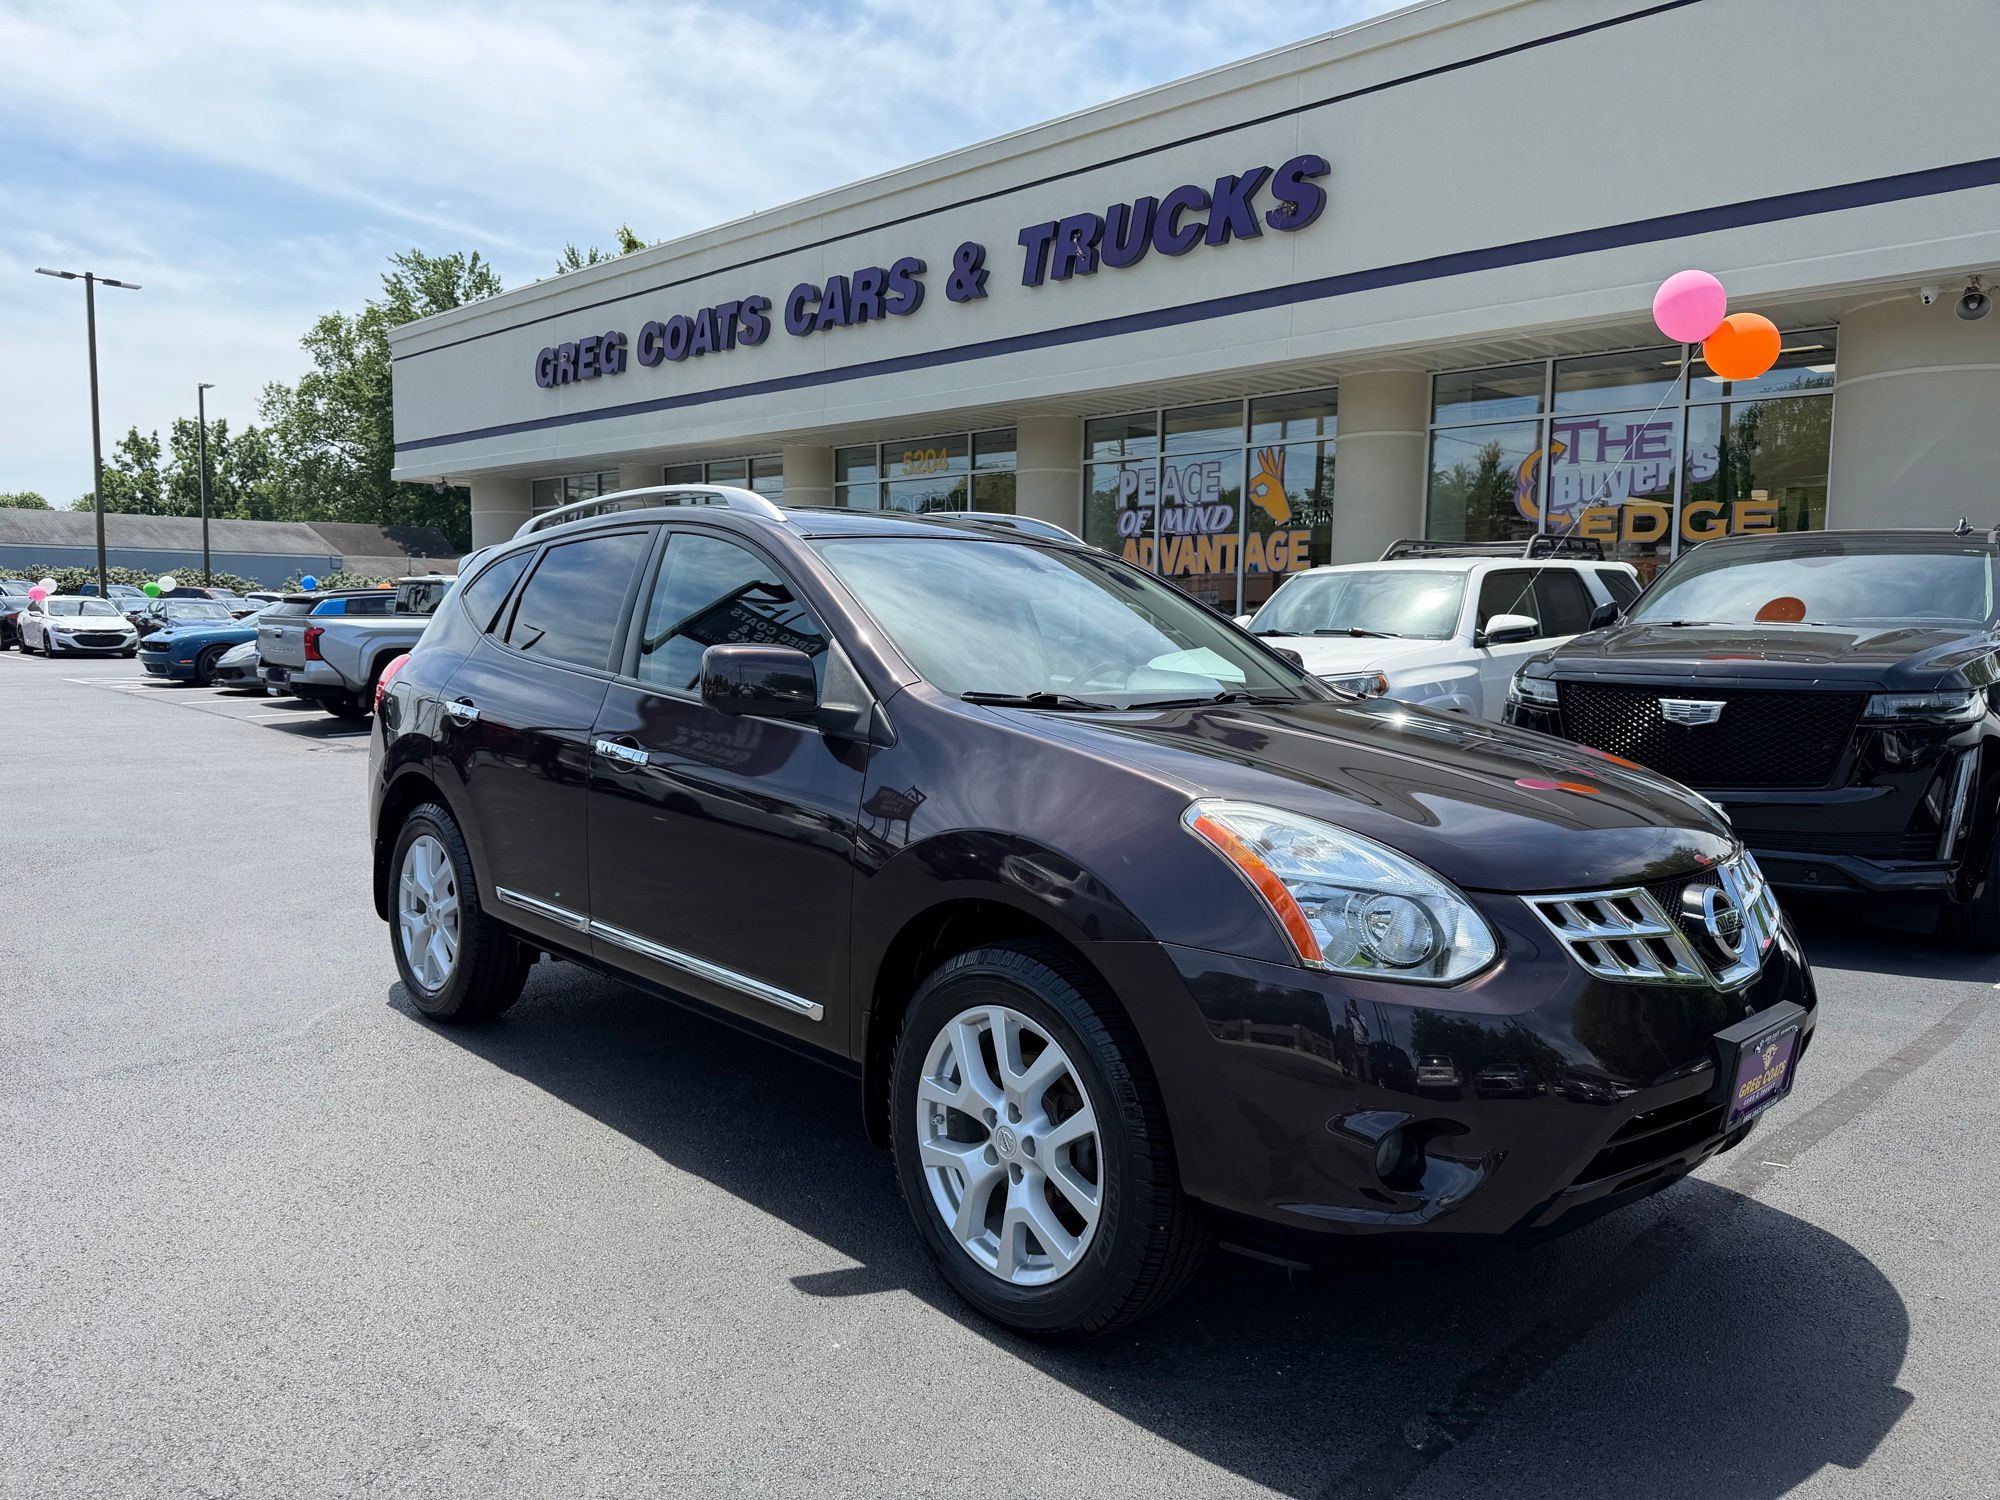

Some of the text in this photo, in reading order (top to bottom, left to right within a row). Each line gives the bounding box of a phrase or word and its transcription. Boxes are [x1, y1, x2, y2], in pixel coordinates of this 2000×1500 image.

[535, 154, 1331, 388] GREG COATS CARS & TRUCKS
[903, 448, 948, 475] 5204
[1552, 418, 1673, 466] THE
[1119, 461, 1221, 509] PEACE
[1117, 504, 1233, 538] OF MIND
[1580, 499, 1778, 543] EDGE
[1121, 530, 1312, 576] ADVANTAGE
[1739, 1059, 1787, 1099] GREG COATS
